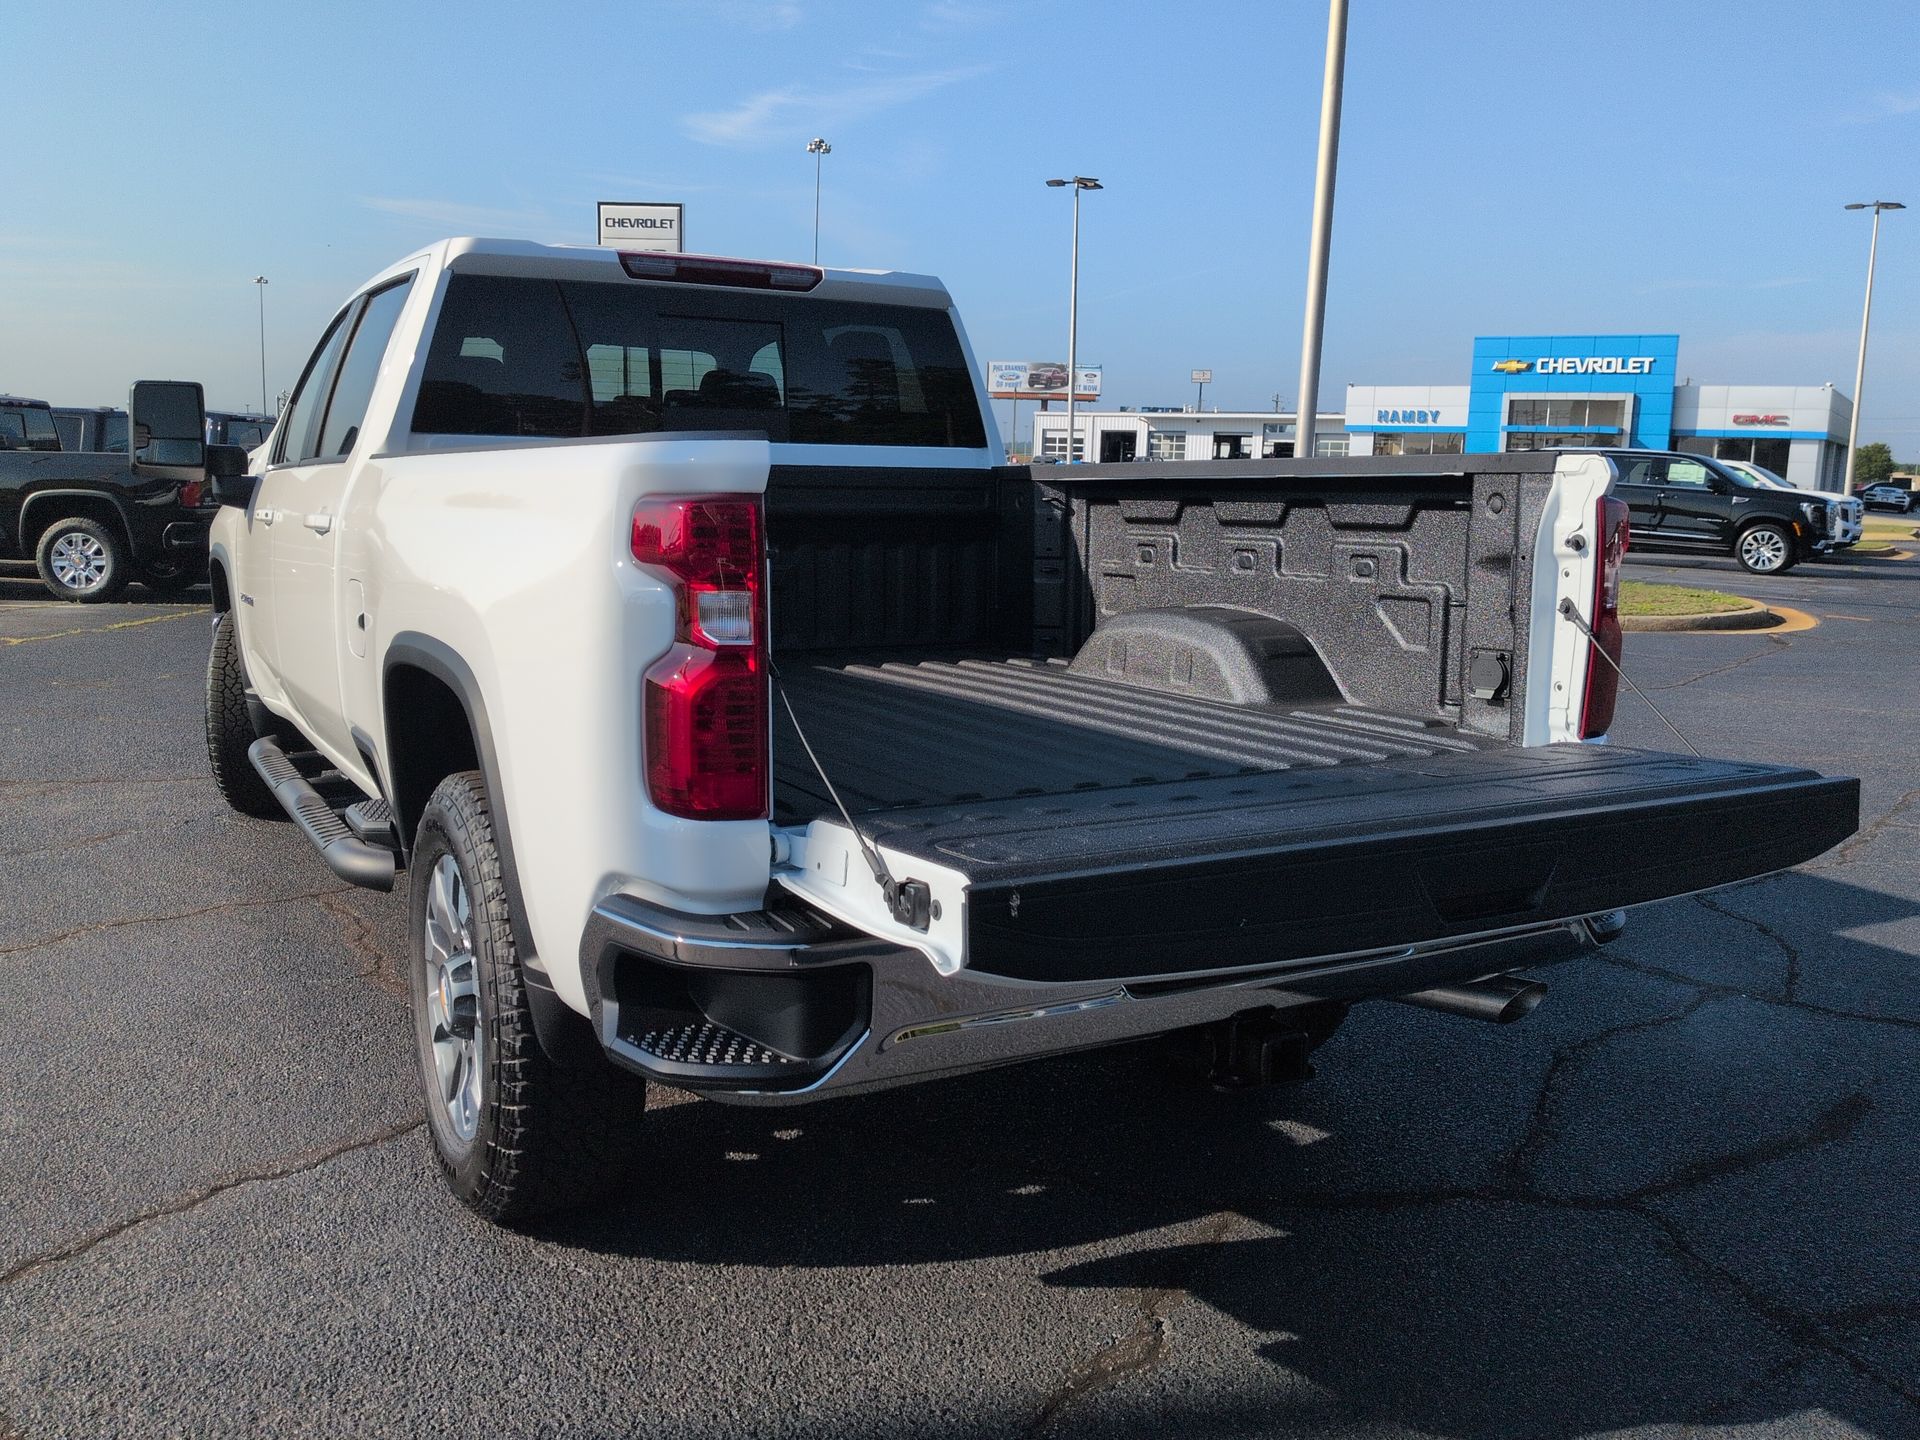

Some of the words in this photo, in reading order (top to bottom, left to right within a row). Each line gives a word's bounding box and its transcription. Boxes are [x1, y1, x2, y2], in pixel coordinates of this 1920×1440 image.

[605, 217, 675, 229] CHEVROLET
[1536, 357, 1655, 375] CHEVROLET
[1083, 384, 1098, 392] NOW
[1377, 409, 1441, 424] HAMBY
[1732, 414, 1790, 426] GMC
